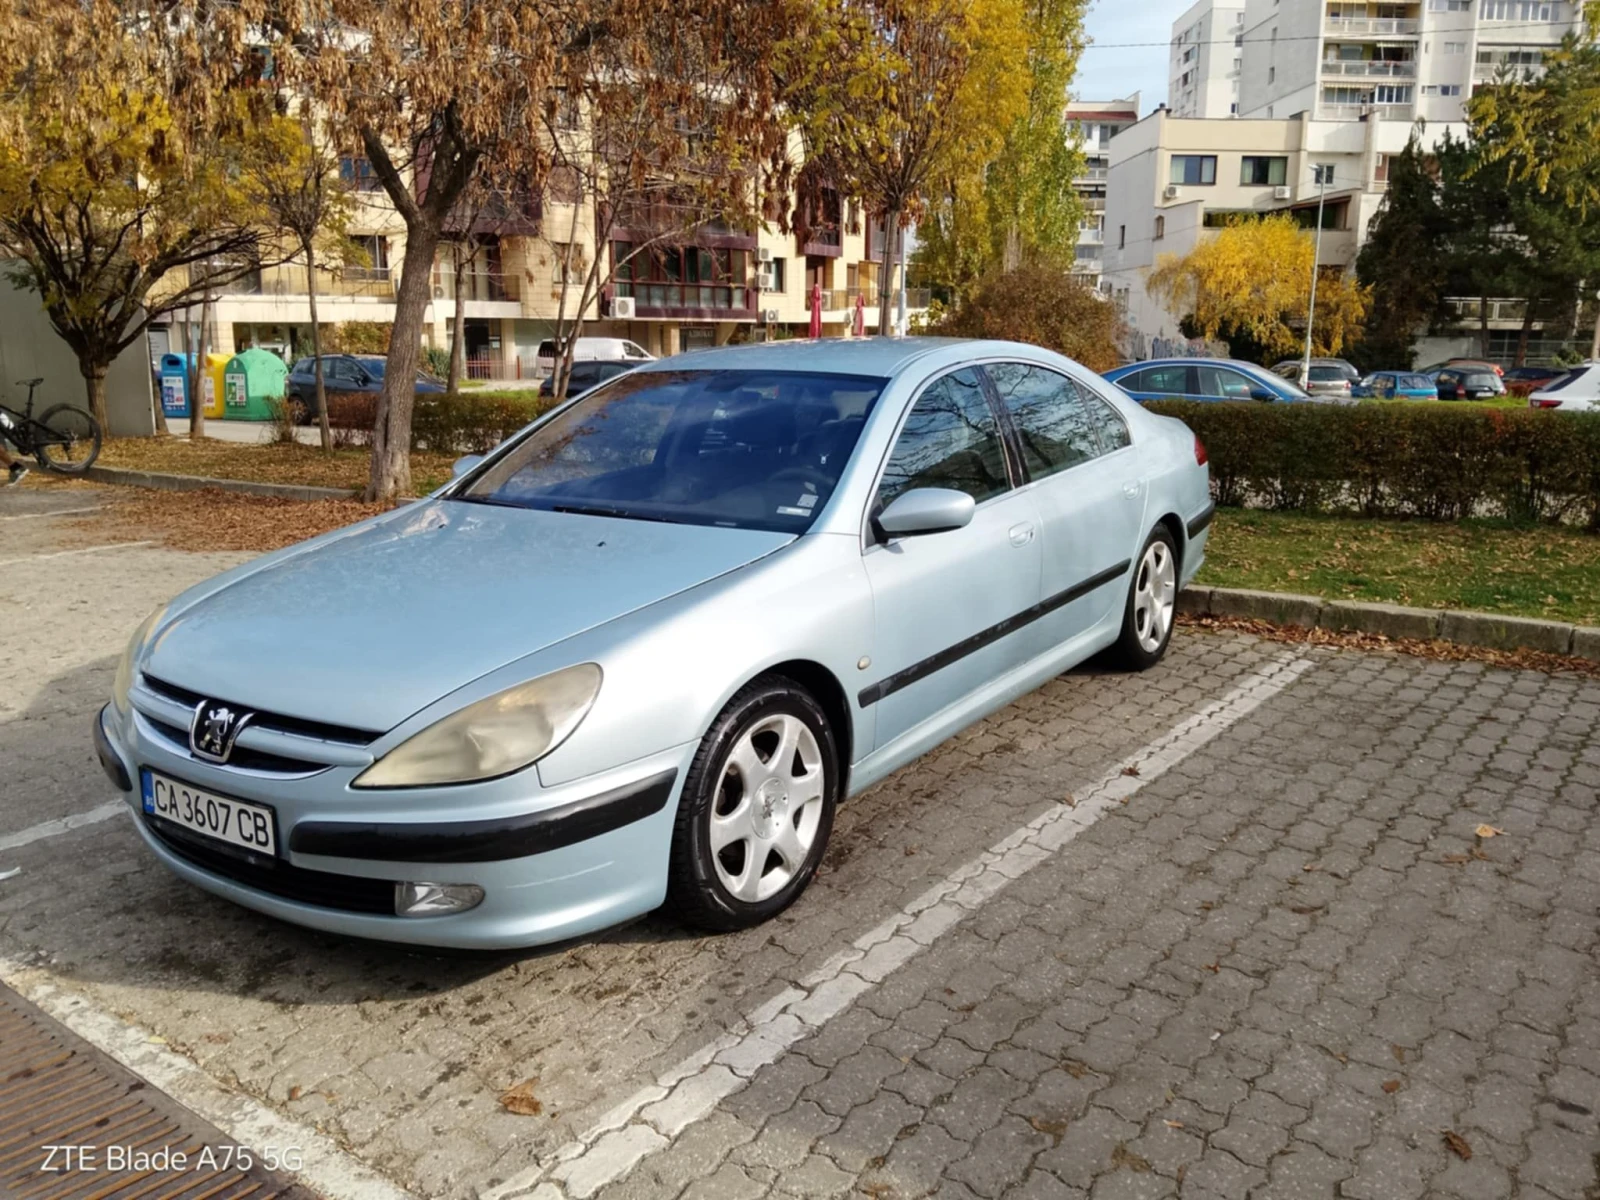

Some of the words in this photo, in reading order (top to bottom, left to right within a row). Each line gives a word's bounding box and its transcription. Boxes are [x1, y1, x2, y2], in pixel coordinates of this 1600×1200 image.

[155, 780, 180, 818] CA
[182, 790, 231, 835] 3607
[237, 808, 269, 847] CB
